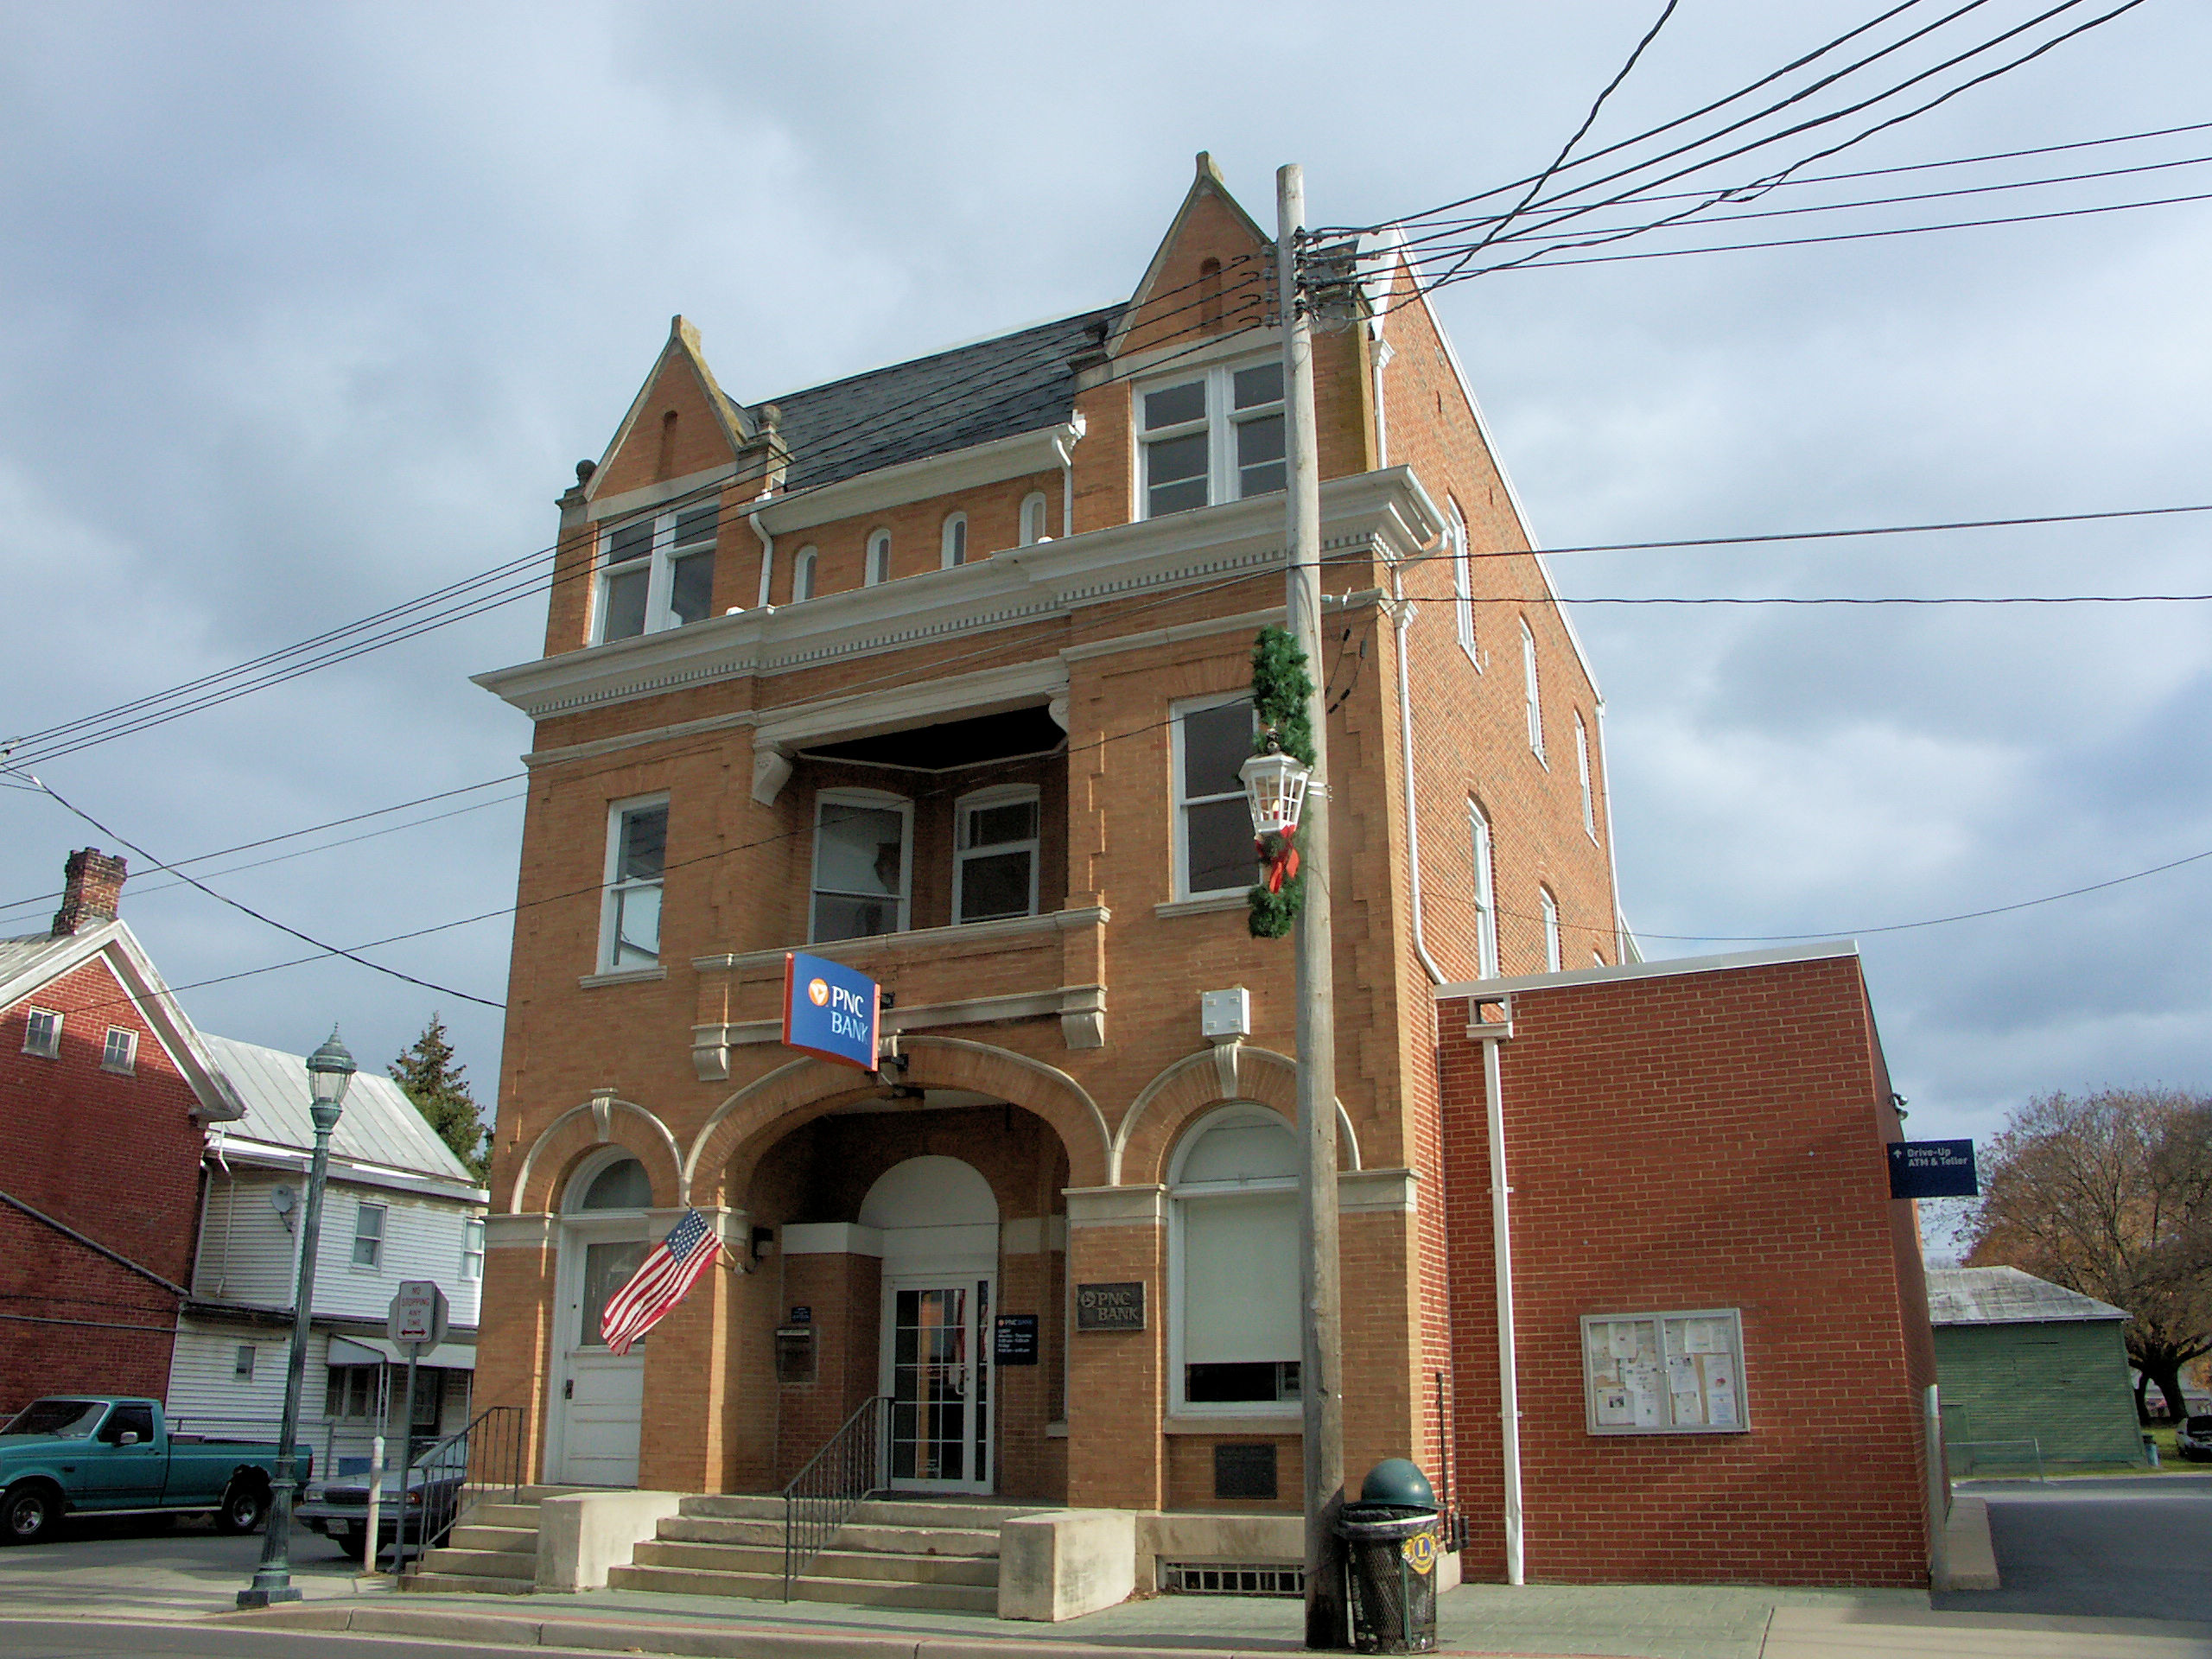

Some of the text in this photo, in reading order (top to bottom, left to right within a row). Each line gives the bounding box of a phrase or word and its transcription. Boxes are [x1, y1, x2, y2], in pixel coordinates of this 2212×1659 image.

[832, 985, 864, 1018] PNC
[830, 1011, 868, 1044] BANK
[1906, 1147, 1951, 1158] Drive-Up
[1908, 1158, 1929, 1167] ATM
[1940, 1157, 1968, 1166] Teller
[412, 1286, 422, 1295] NO
[1096, 1291, 1134, 1306] PNC
[1097, 1306, 1140, 1322] BANK
[1417, 1539, 1429, 1558] L
